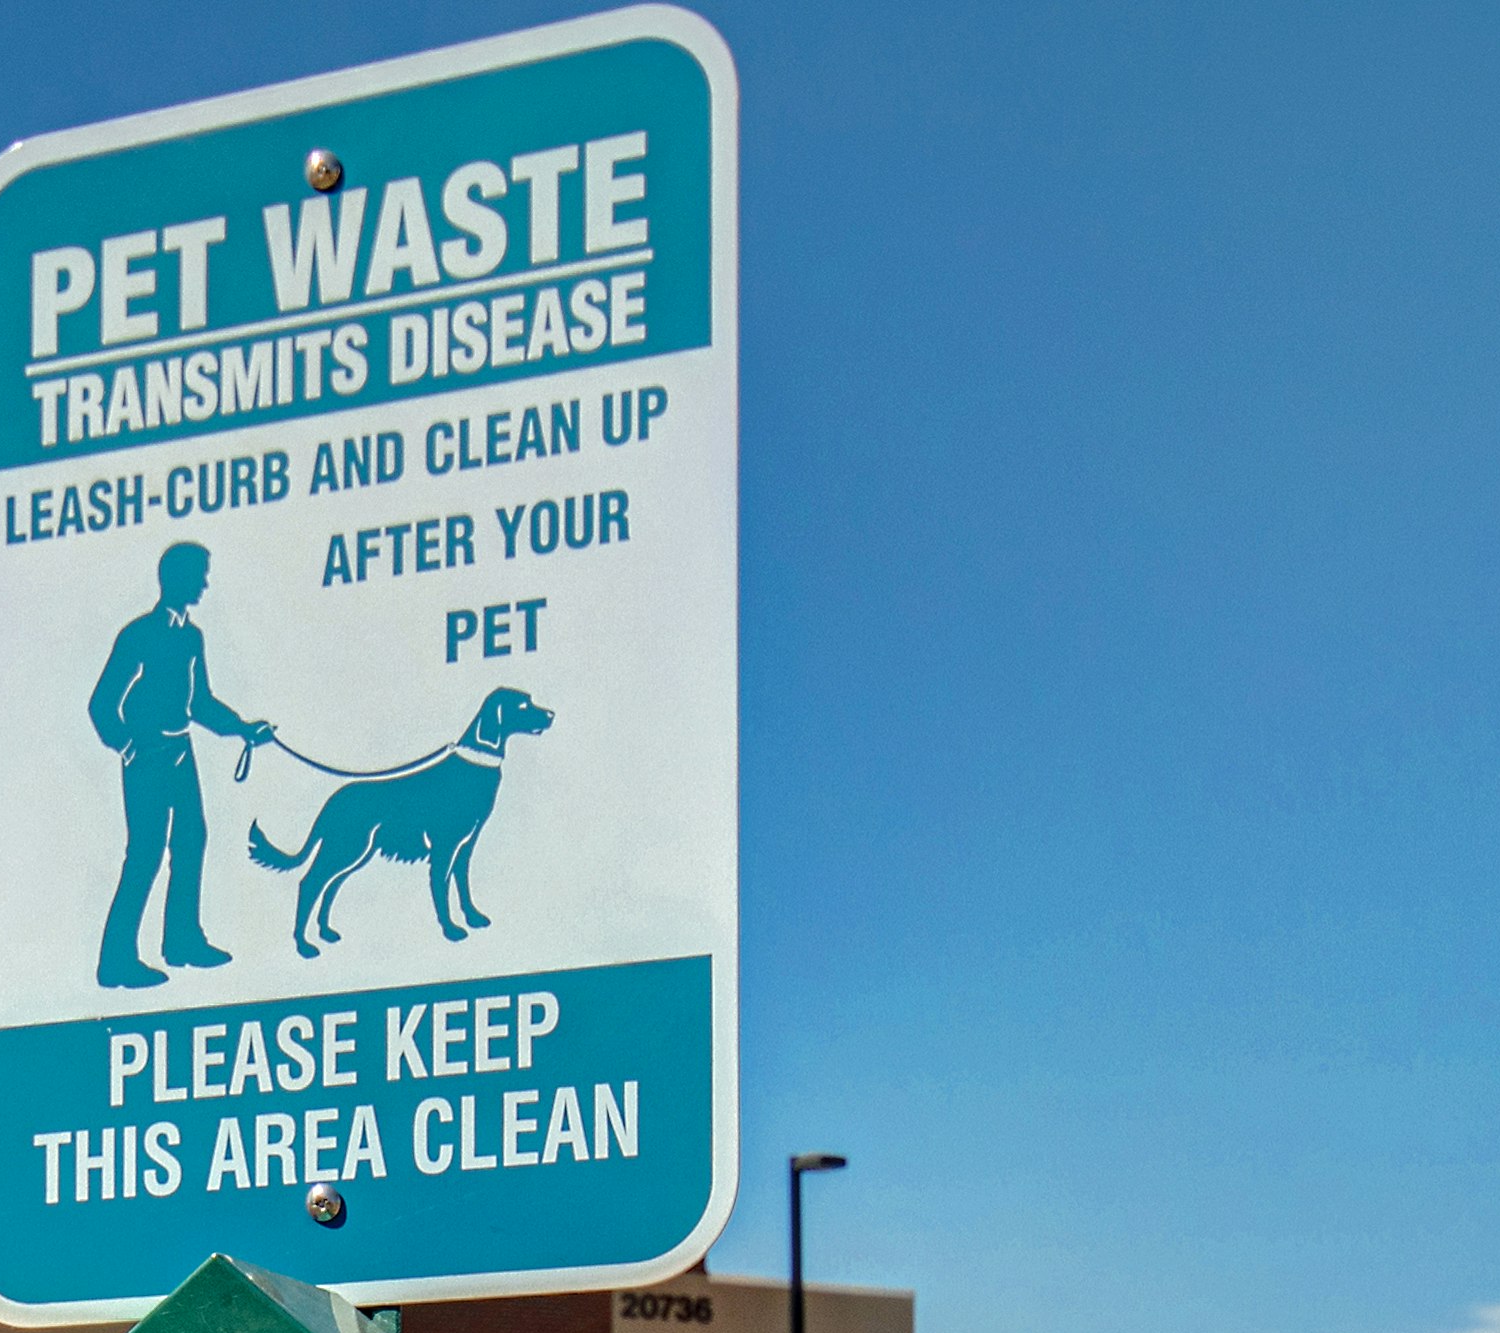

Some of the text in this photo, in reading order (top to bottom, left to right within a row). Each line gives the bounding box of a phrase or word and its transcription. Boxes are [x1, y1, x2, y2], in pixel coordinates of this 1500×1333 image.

[31, 130, 649, 359] PET WASTE
[31, 271, 647, 447] TRANSMITS DISEASE
[6, 386, 668, 545] LEASH-CURB AND CLEAN UP
[322, 489, 630, 587] AFTER YOUR
[446, 598, 547, 664] PET
[109, 991, 560, 1107] PLEASE KEEP
[32, 1080, 639, 1205] THIS AREA CLEAN
[620, 1292, 714, 1325] 20736
